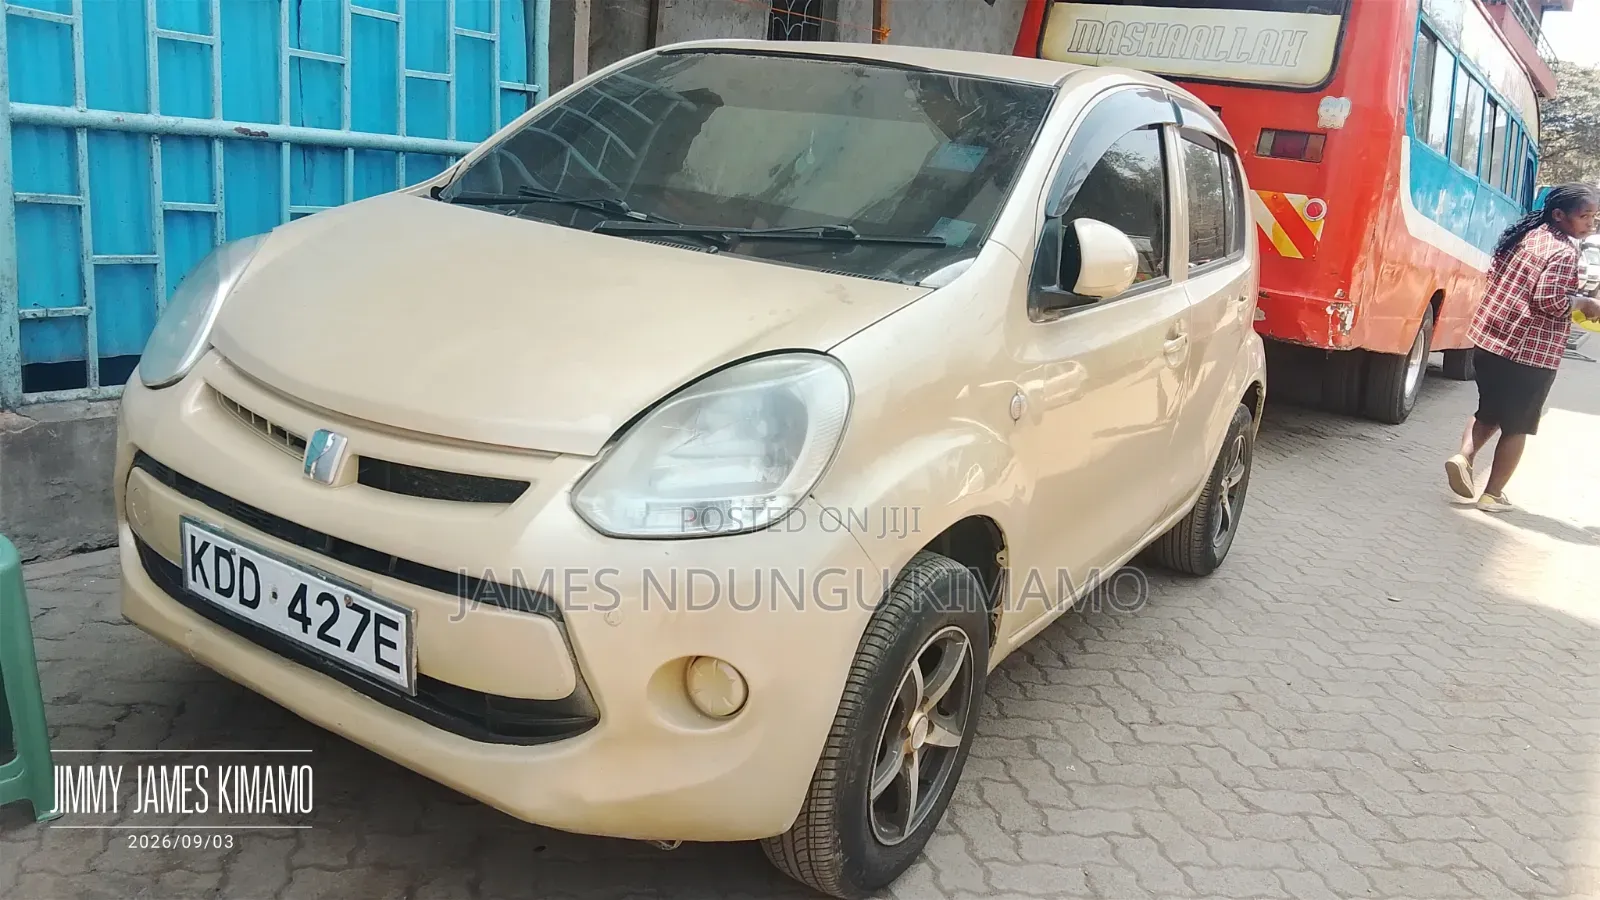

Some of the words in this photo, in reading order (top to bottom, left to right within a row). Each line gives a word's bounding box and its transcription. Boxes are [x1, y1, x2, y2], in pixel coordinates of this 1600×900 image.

[1067, 18, 1308, 67] MASHAALLAH
[190, 534, 261, 610] KDD
[287, 582, 401, 674] 427E
